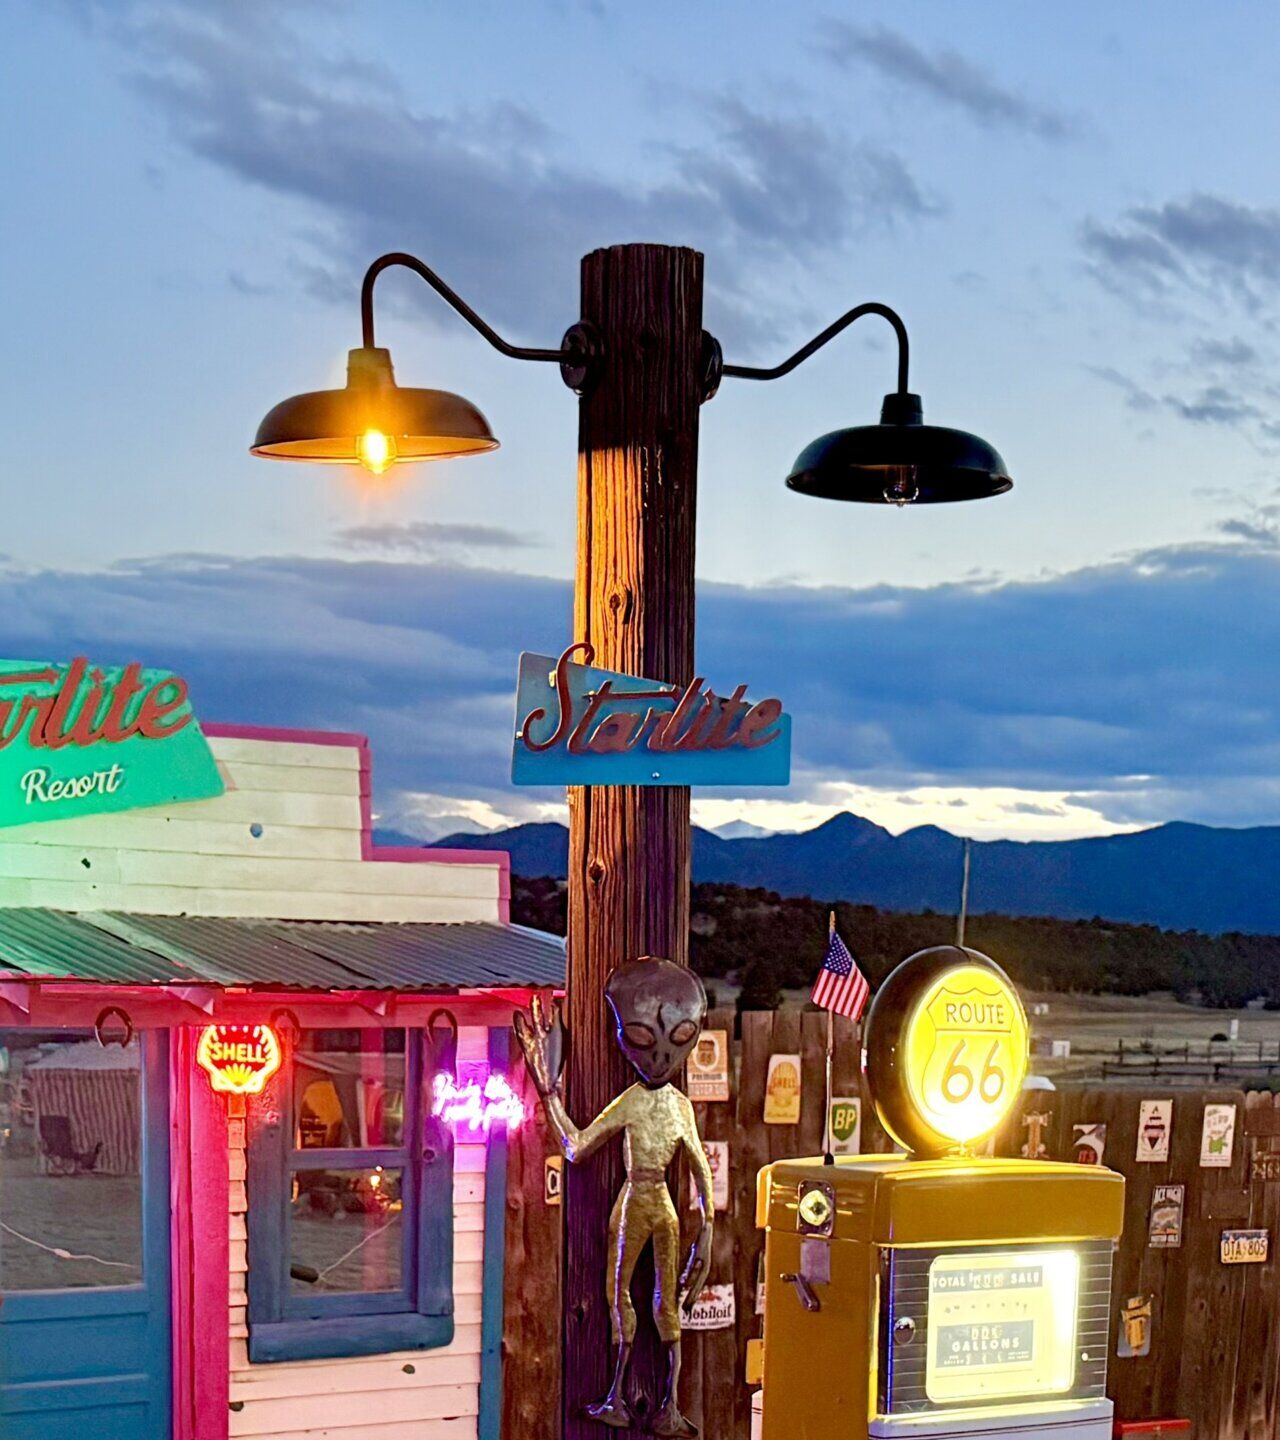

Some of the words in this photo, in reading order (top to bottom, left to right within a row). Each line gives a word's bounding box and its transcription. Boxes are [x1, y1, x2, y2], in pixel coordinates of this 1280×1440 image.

[521, 642, 782, 754] Starlite
[21, 763, 124, 804] Resort
[945, 1003, 1005, 1024] ROUTE
[211, 1042, 266, 1063] SHELL
[941, 1039, 1004, 1104] 66
[834, 1109, 856, 1130] BP
[933, 1276, 966, 1288] TOTAL
[951, 1337, 1020, 1353] GALLONS
